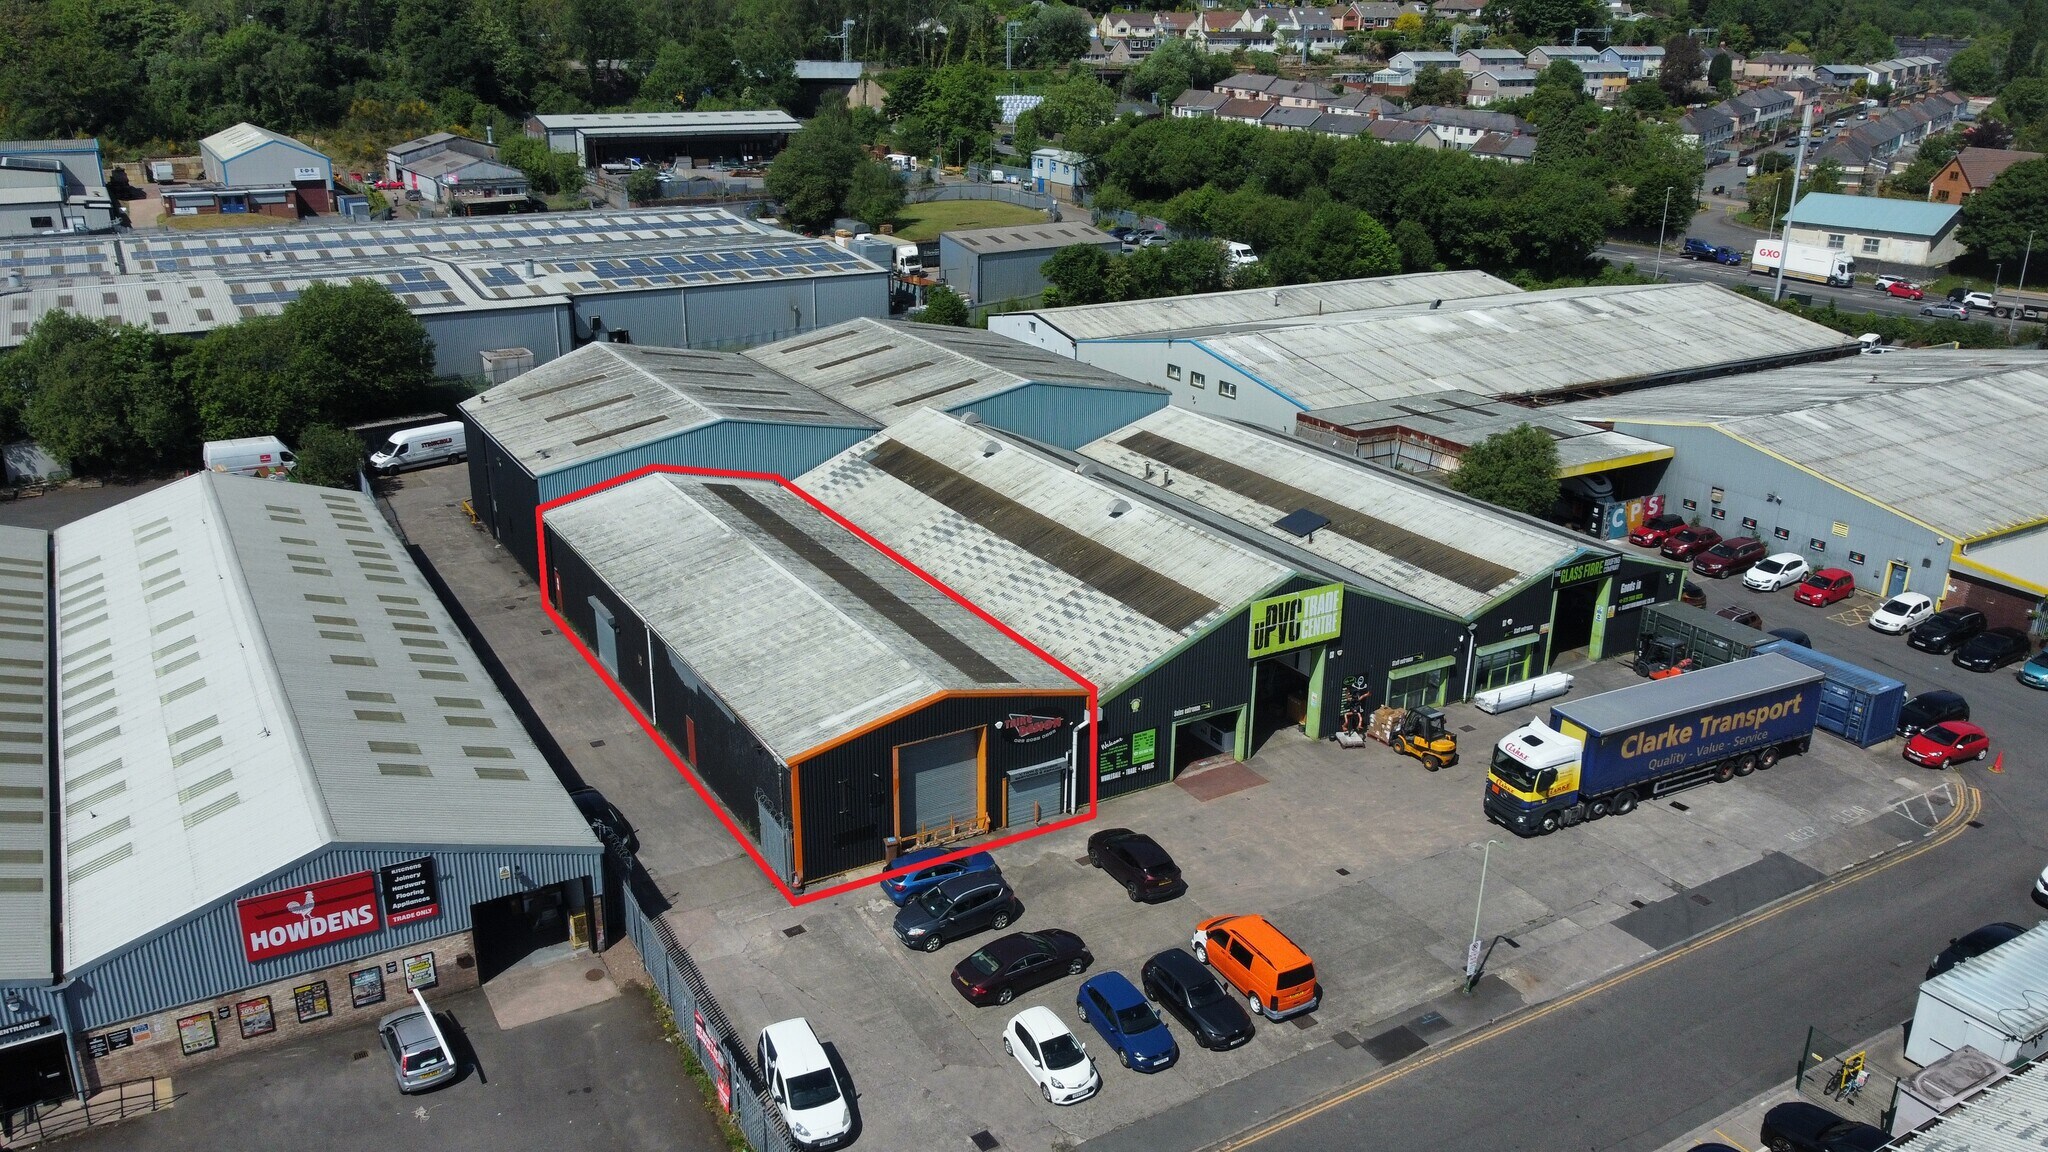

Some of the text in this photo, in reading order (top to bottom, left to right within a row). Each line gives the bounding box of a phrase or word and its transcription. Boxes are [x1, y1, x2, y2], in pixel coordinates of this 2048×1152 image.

[1759, 248, 1781, 259] GXO
[1560, 565, 1583, 584] GLASS
[1583, 560, 1605, 577] FIBRE
[1303, 590, 1340, 618] TRADE
[1254, 598, 1302, 650] uPVC
[1301, 613, 1337, 640] CENTRE
[1019, 717, 1062, 736] DESIGN
[1621, 692, 1803, 759] Clarke Transport
[1100, 737, 1124, 750] Welcome
[1648, 753, 1687, 770] Quality
[1697, 741, 1725, 756] Value
[1734, 729, 1768, 747] Service
[1101, 761, 1155, 782] WHOLESALE TRADE PUBLIC
[1784, 805, 1873, 843] KEEP CLEAR
[391, 879, 426, 892] Hardware
[394, 872, 421, 882] Joinery
[392, 896, 431, 909] Appliances
[395, 888, 425, 900] Flooring
[392, 908, 433, 923] TRADE ONLY
[250, 904, 374, 952] HOWDENS
[0, 1020, 41, 1036] ENTRANCE
